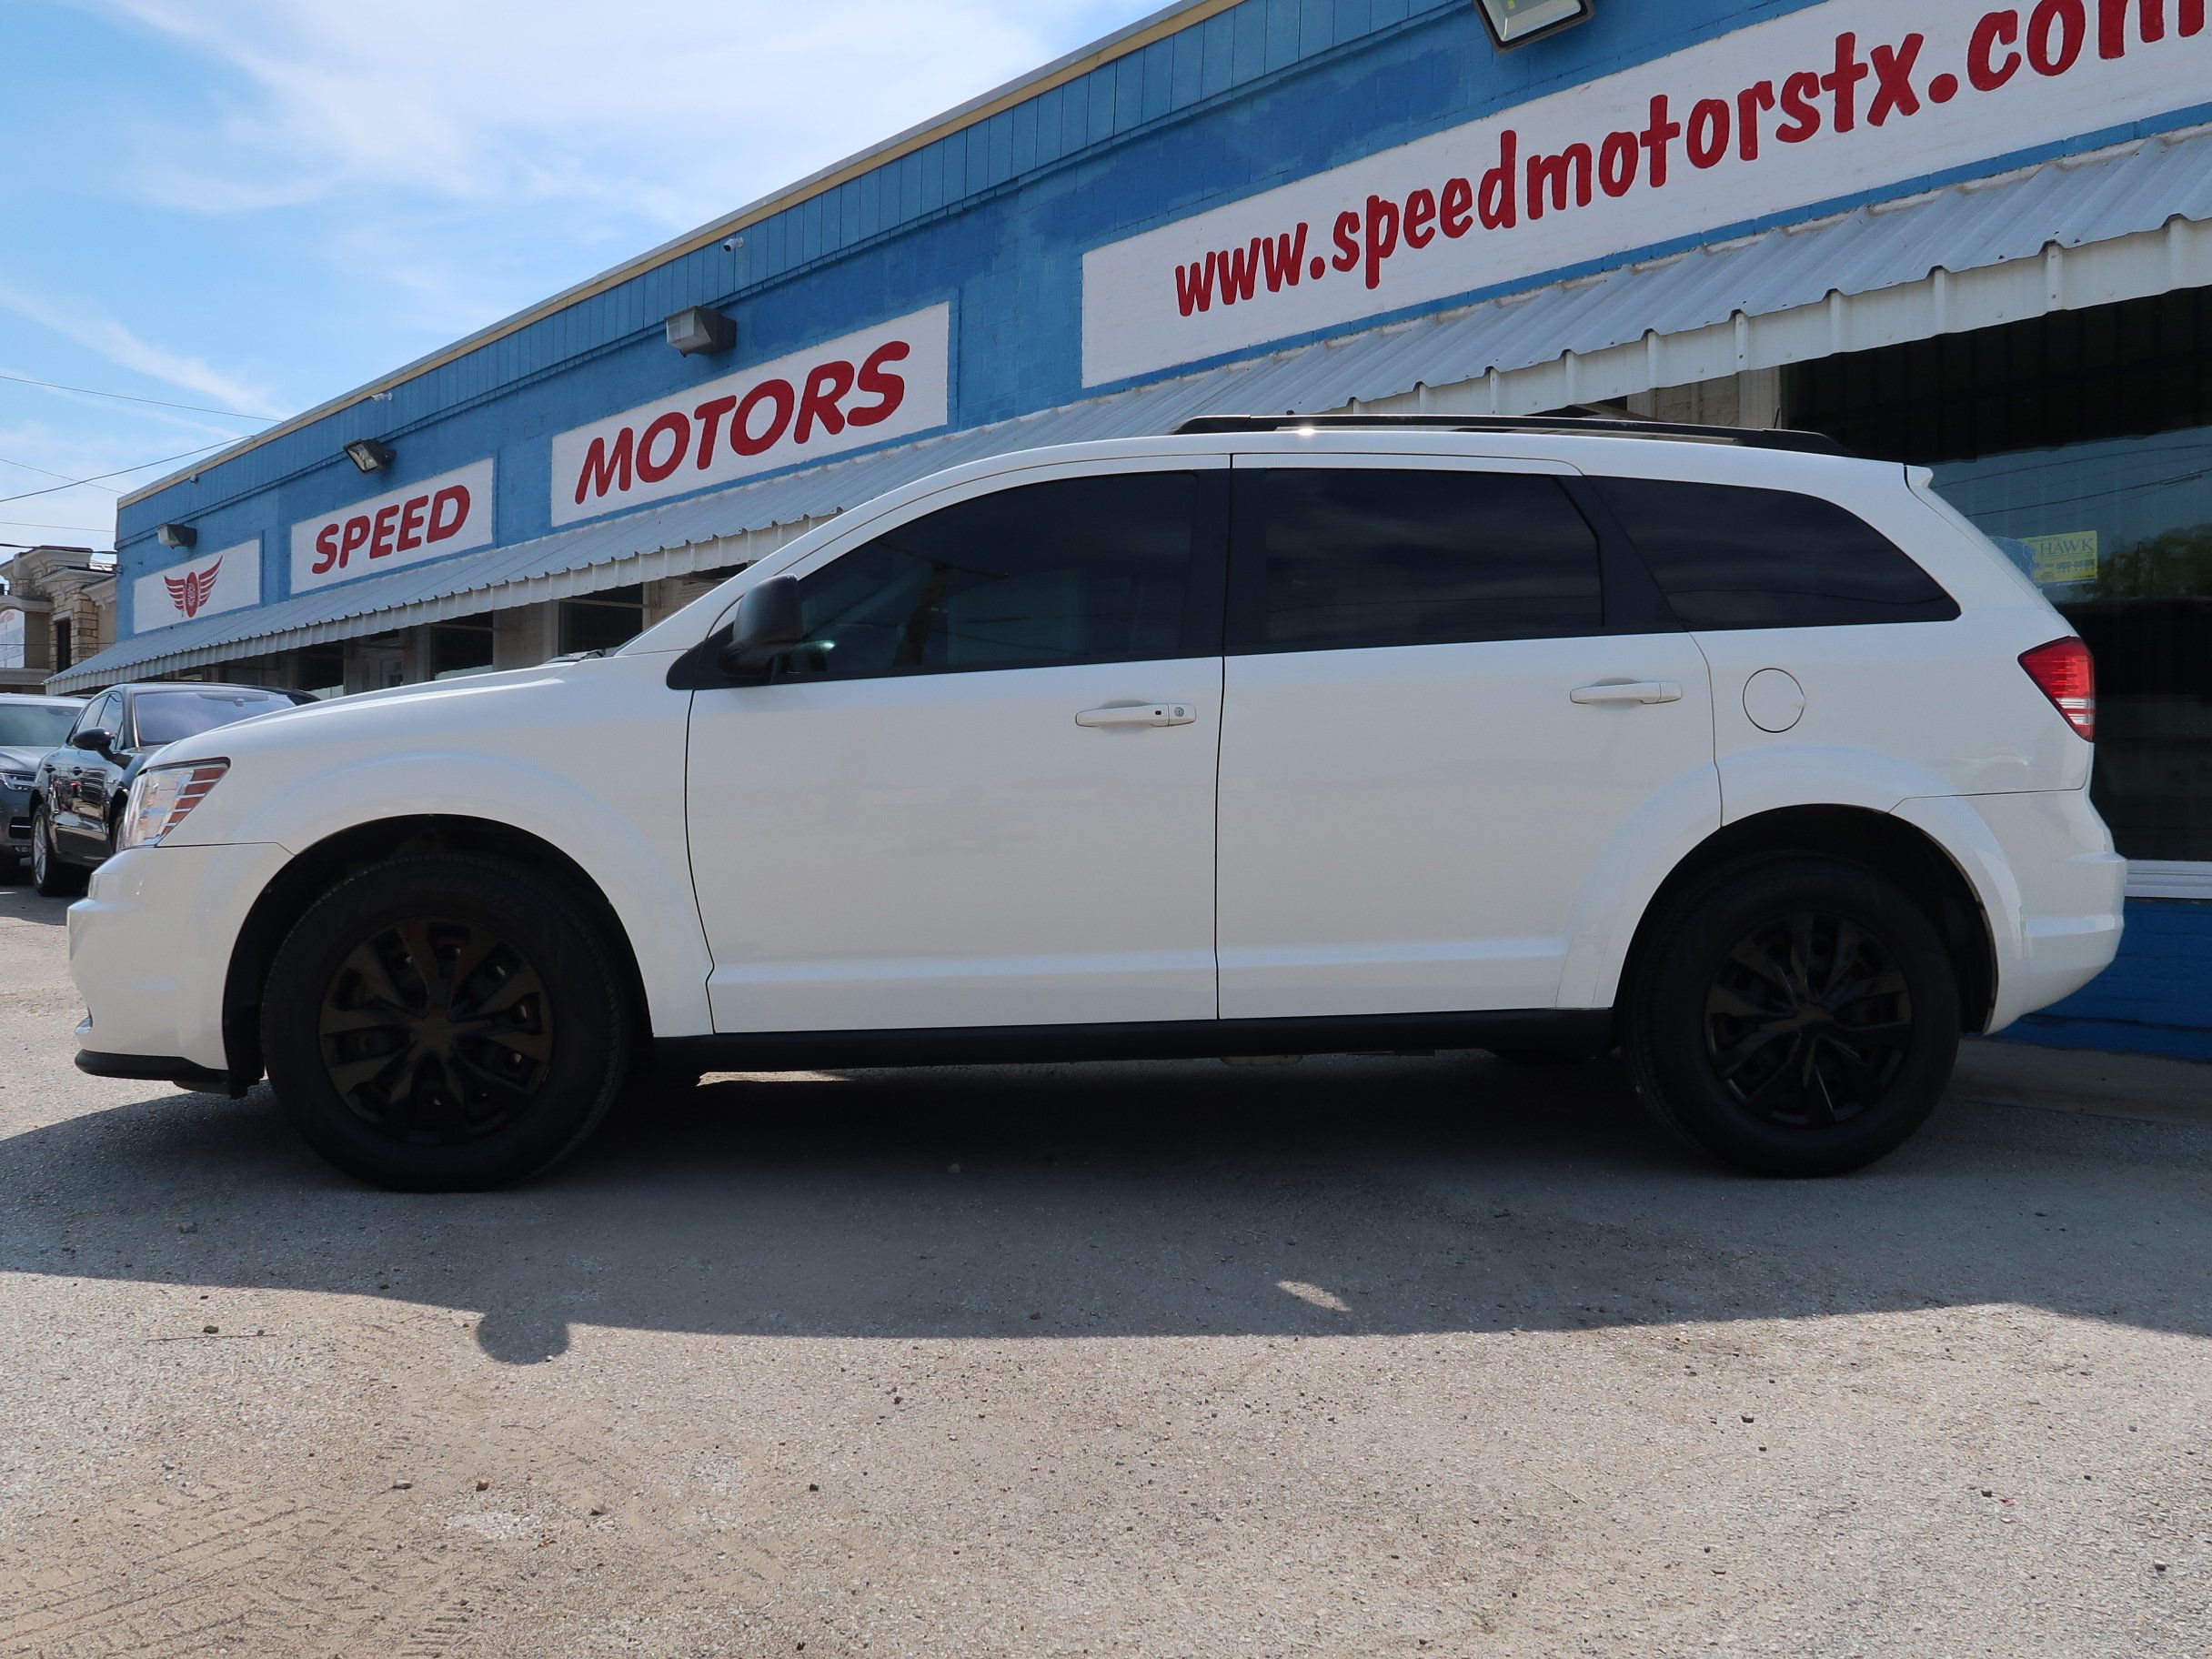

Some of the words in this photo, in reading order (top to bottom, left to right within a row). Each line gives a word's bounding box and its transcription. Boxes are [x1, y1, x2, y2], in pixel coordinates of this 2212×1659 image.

[576, 341, 910, 502] MOTORS
[311, 485, 470, 574] SPEED
[2039, 538, 2095, 555] HAWK
